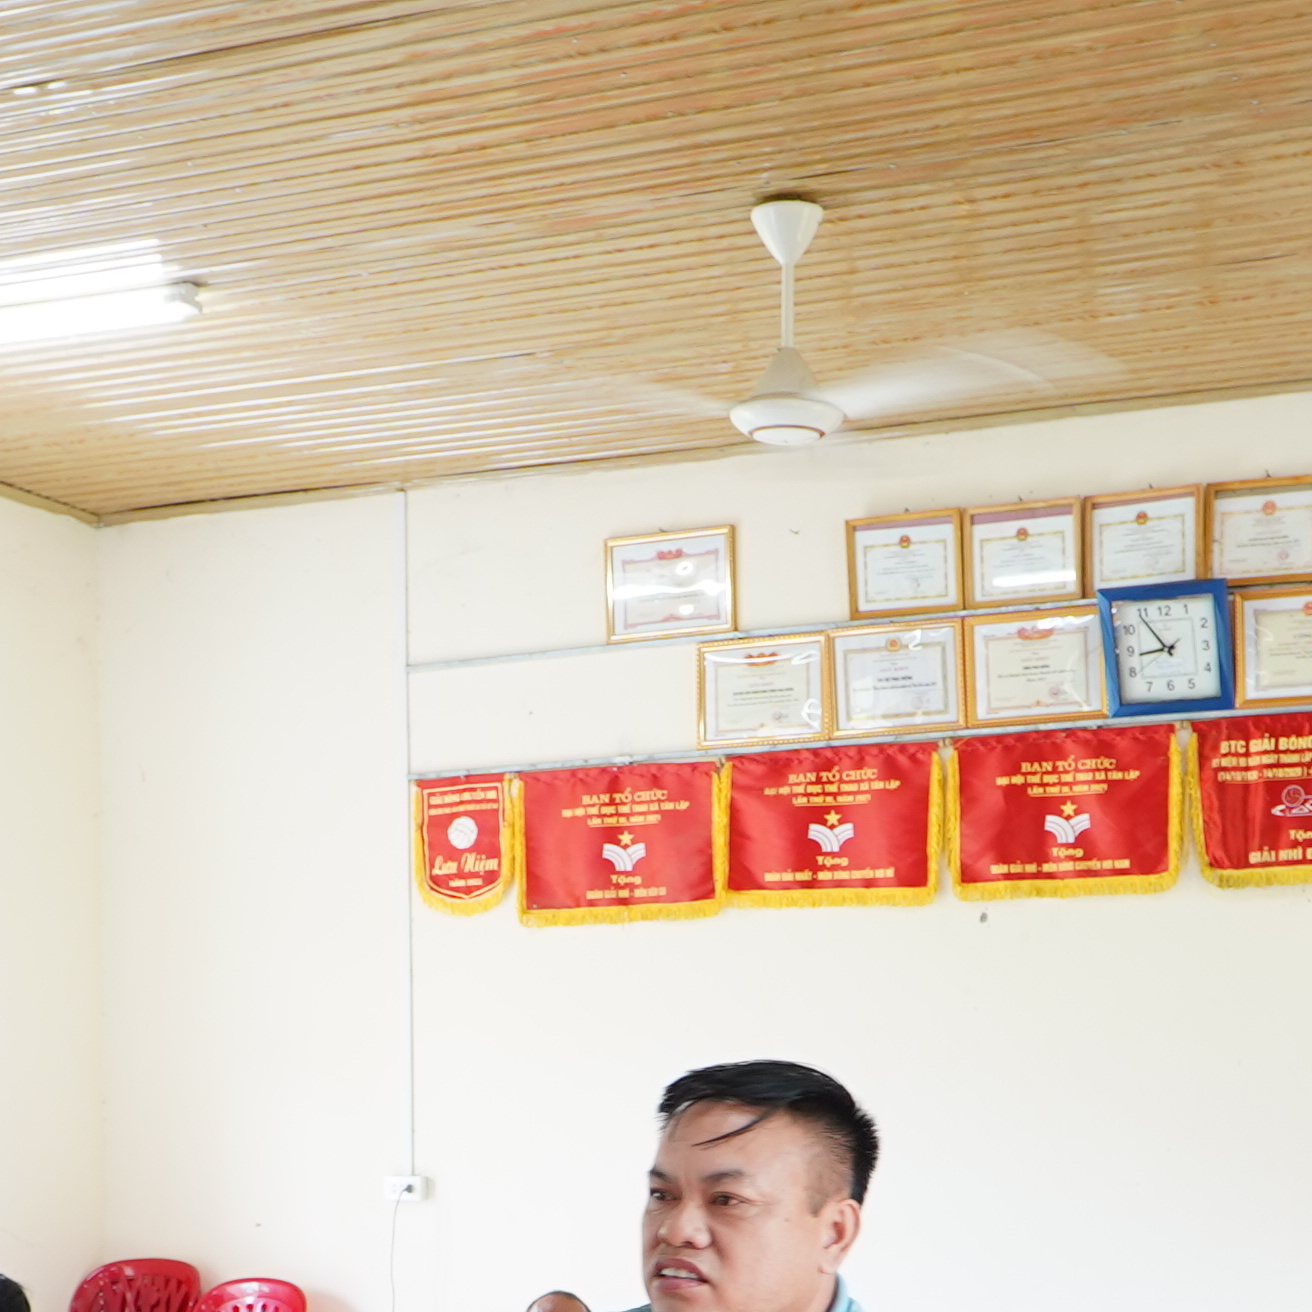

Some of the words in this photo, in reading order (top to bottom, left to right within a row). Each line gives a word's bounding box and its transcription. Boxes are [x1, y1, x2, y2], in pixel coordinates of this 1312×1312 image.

[1157, 606, 1171, 616] 12
[1184, 604, 1188, 614] 1
[1200, 618, 1208, 628] 2
[1123, 625, 1135, 635] 10
[1202, 640, 1210, 651] 3
[1126, 646, 1134, 657] 9
[1129, 667, 1136, 678] 8
[1204, 663, 1212, 672] 4
[1145, 682, 1153, 692] 7
[1167, 680, 1175, 691] 6
[1188, 679, 1195, 689] 5
[1220, 740, 1246, 754] BTC
[1250, 733, 1275, 752] GIẢI
[1021, 761, 1053, 772] BAN
[1056, 755, 1075, 771] TỔ
[1078, 756, 1117, 769] CHỨC
[789, 772, 816, 784] BAN
[819, 766, 840, 781] TỔ
[842, 767, 877, 781] CHỨC
[582, 794, 610, 804] BAN
[613, 787, 632, 803] TỔ
[634, 788, 667, 801] CHỨC
[1052, 848, 1084, 858] Tặng
[1249, 846, 1275, 864] GIẢI
[1279, 847, 1302, 861] NHÌ
[816, 856, 849, 867] Tặng
[610, 875, 642, 885] Tặng
